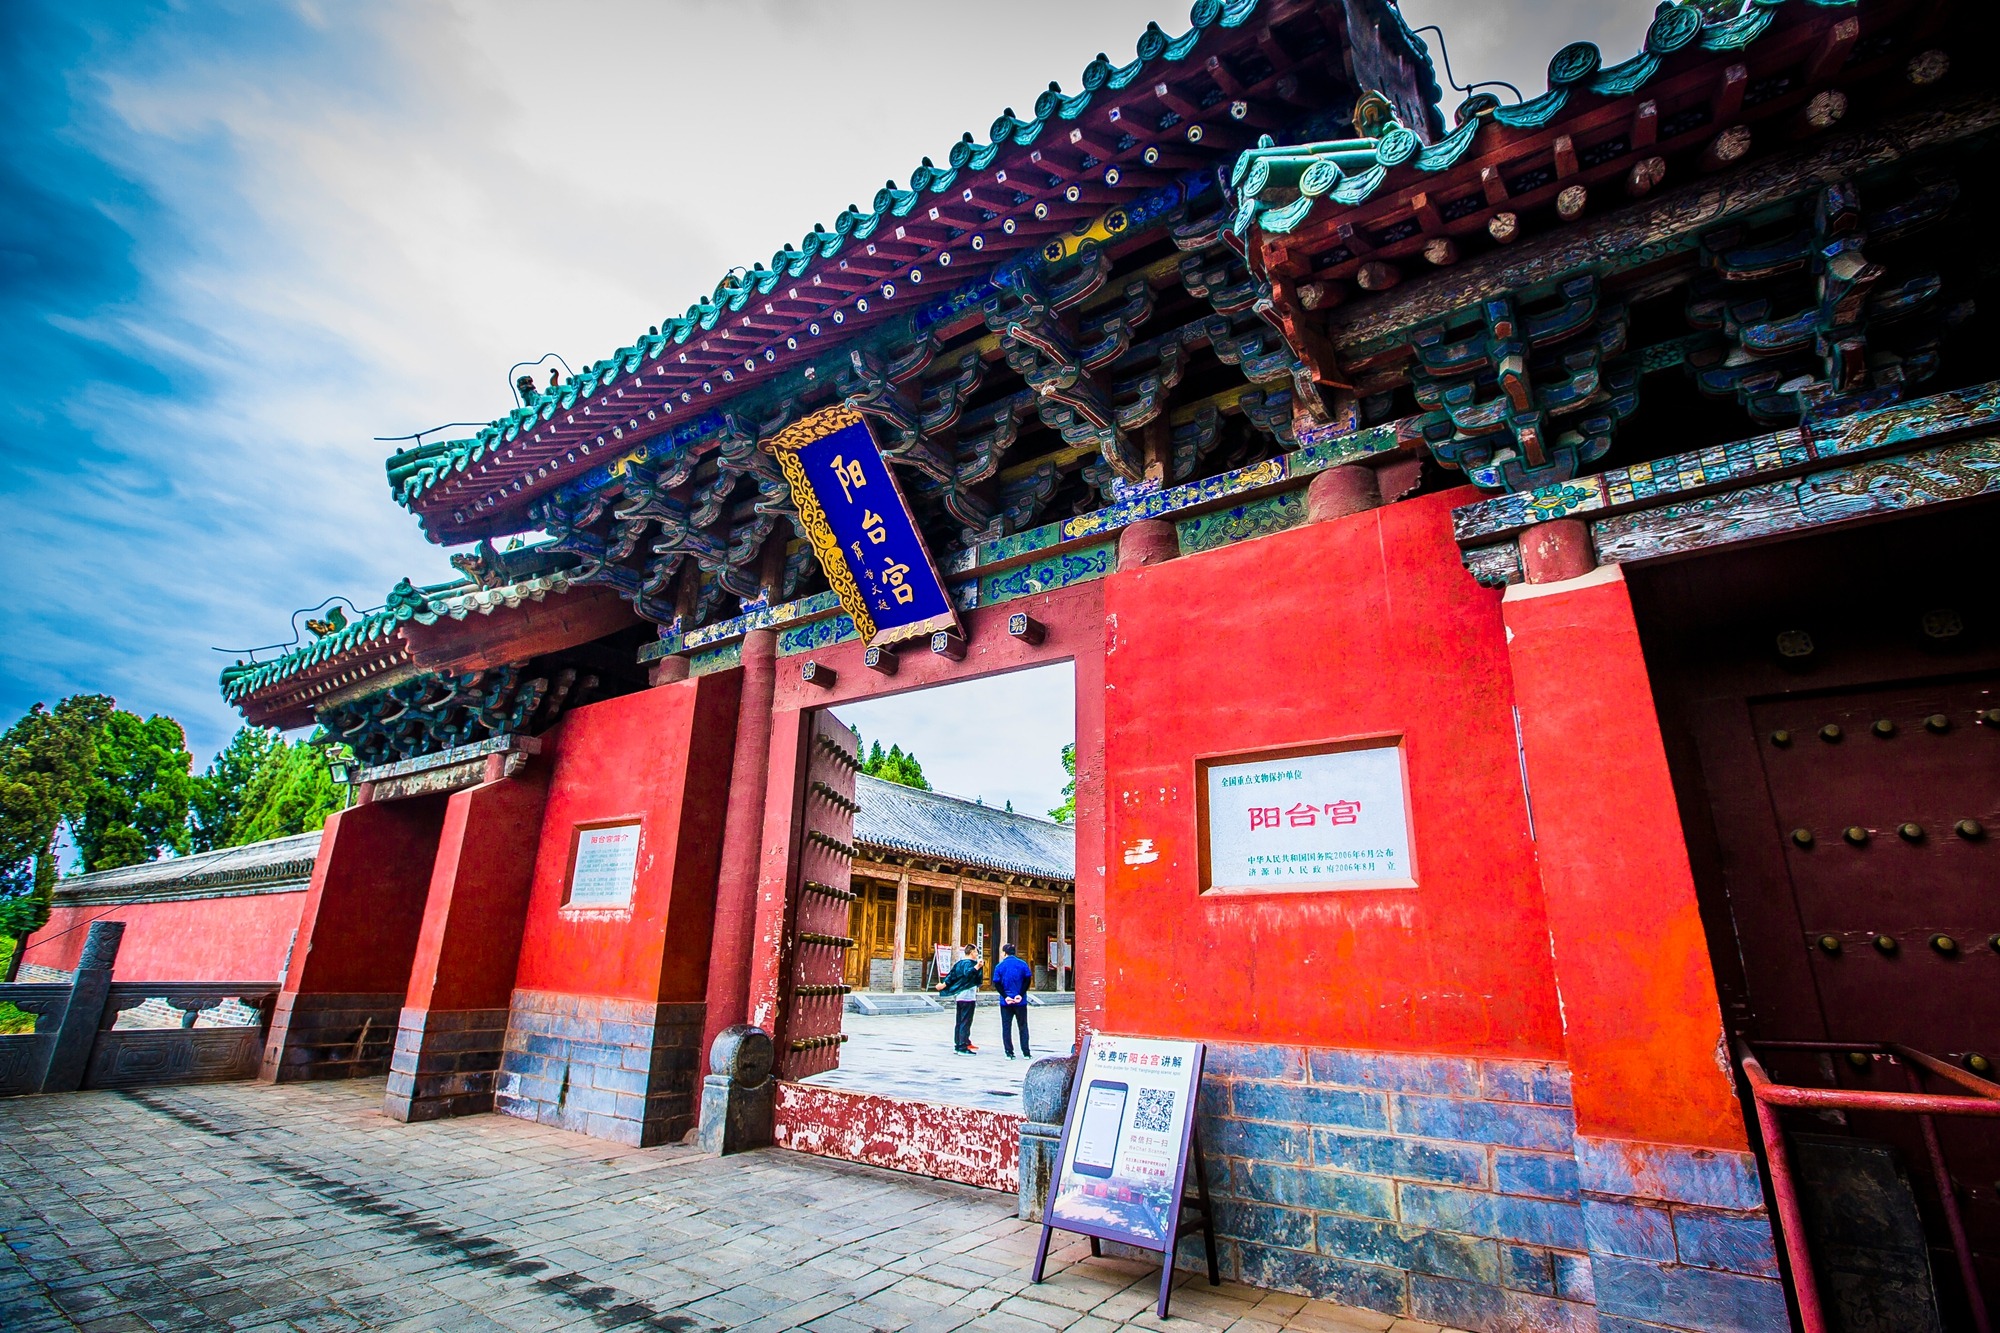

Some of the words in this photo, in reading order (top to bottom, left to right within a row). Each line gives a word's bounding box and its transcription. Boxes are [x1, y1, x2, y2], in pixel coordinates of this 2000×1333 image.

[830, 454, 914, 605] 阳台宫
[1221, 769, 1303, 788] 全国重点文物保护单位
[1247, 799, 1361, 831] 阳台宫
[1097, 1049, 1183, 1068] 免费听阳台宫讲解
[1130, 1135, 1169, 1148] 微信扫一扫
